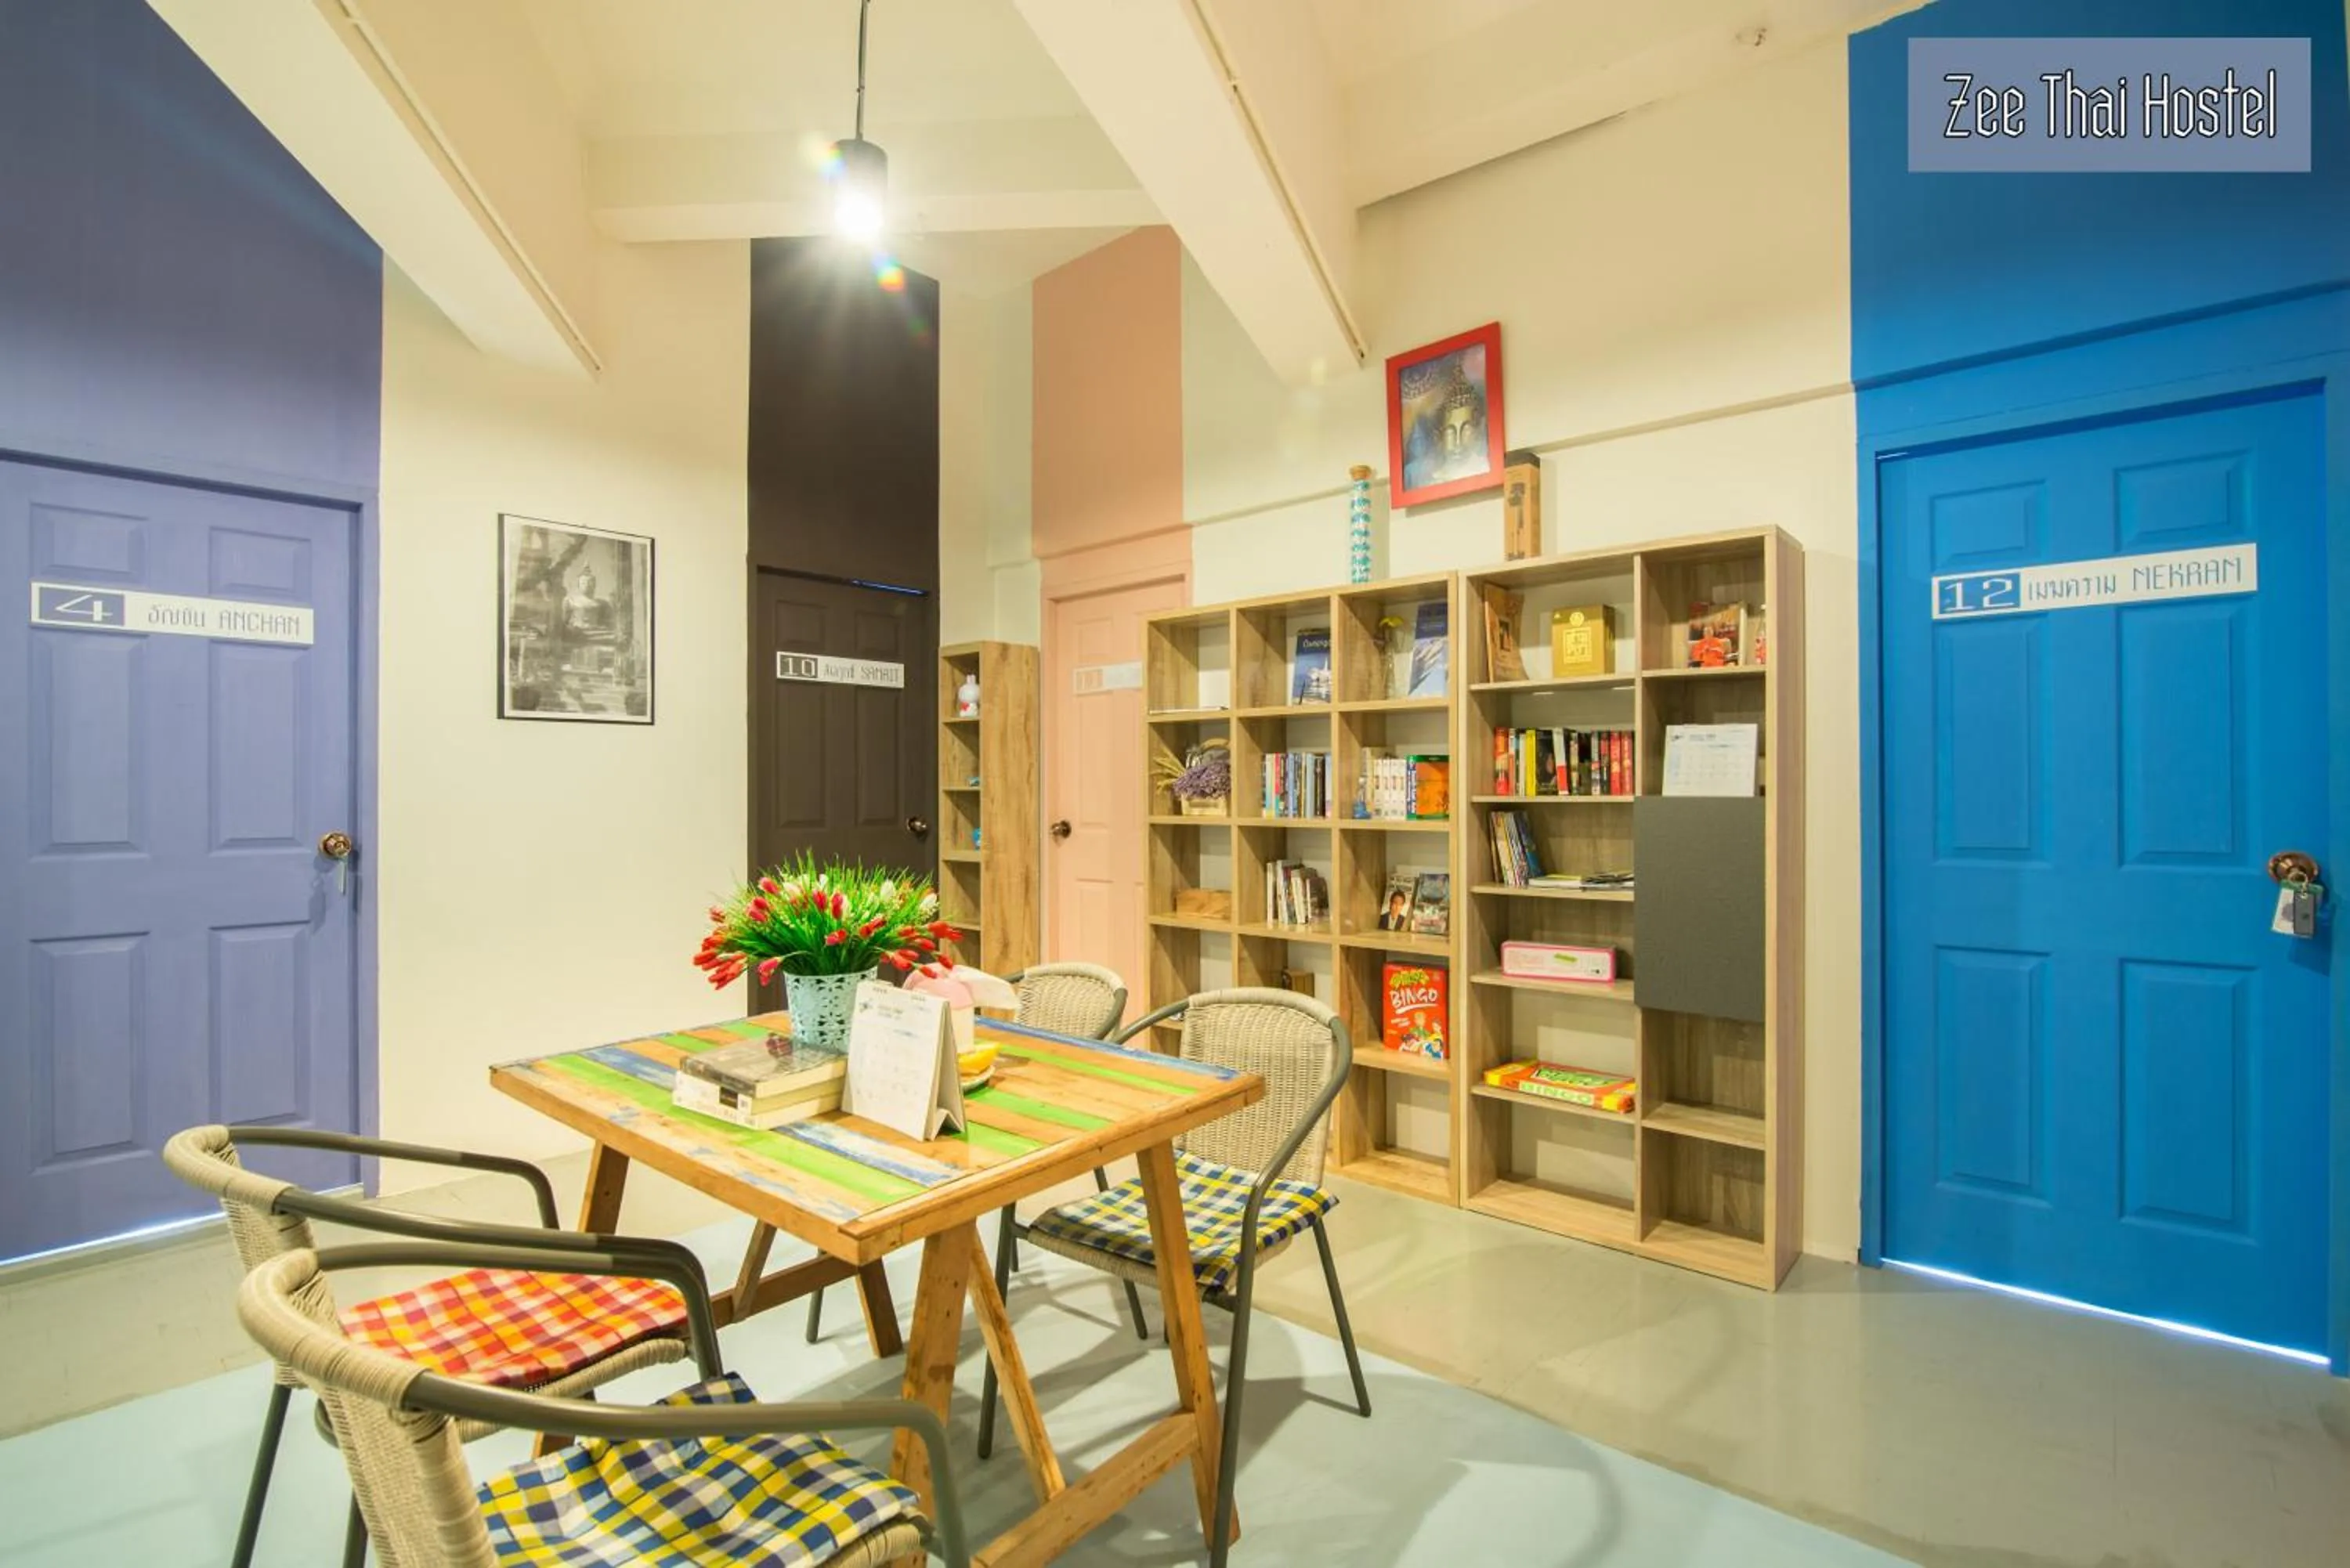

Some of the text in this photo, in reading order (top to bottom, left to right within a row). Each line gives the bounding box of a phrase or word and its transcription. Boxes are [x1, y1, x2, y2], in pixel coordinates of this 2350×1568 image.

[1944, 578, 2014, 612] 12
[2132, 556, 2242, 592] MEKRAM
[55, 594, 114, 622] 4
[219, 609, 301, 636] ANCHAN
[783, 658, 815, 677] 10
[1390, 988, 1438, 1009] BINGO
